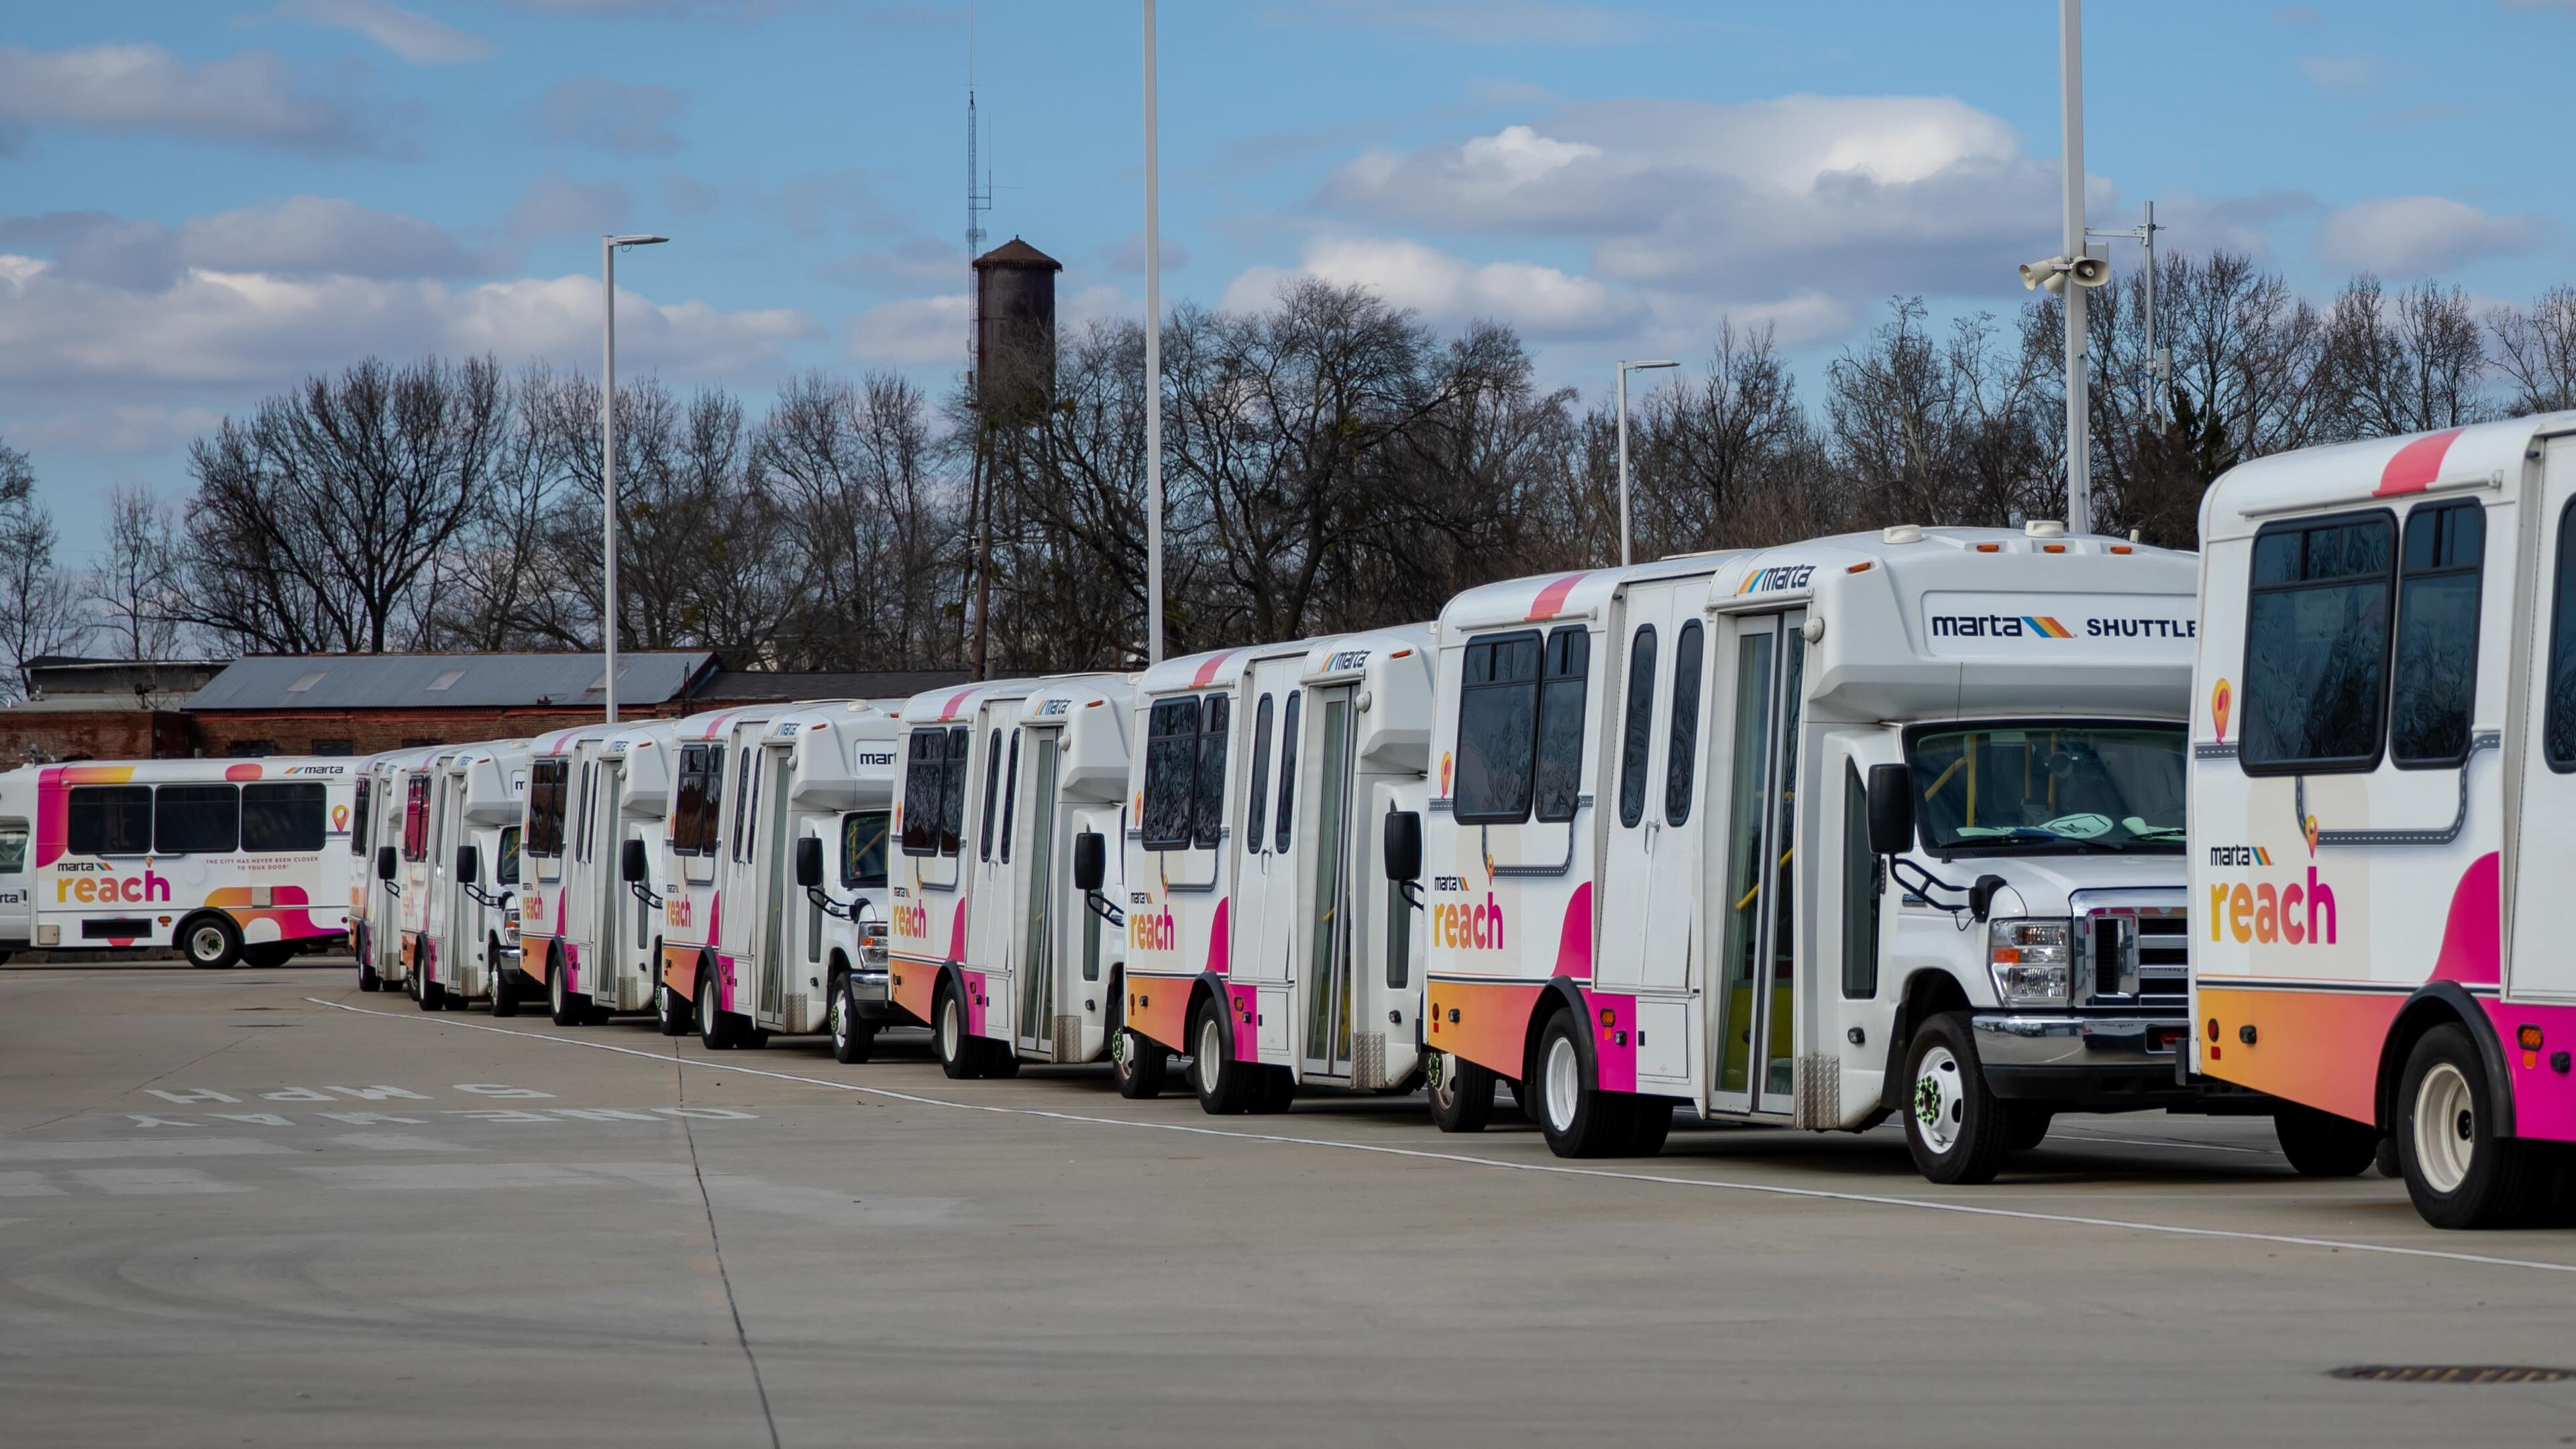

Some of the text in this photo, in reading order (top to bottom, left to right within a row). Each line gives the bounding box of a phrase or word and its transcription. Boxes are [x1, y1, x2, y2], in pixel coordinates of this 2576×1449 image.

[1761, 564, 1817, 592] marta
[1932, 614, 2196, 637] marta SHUTTLE
[1335, 649, 1372, 670] marta
[860, 753, 897, 765] mar
[58, 861, 94, 871] marta
[2210, 845, 2250, 866] marta
[57, 870, 170, 903] reach
[1434, 875, 1457, 891] marta
[0, 894, 18, 903] rta
[523, 891, 543, 920] reach
[2210, 865, 2337, 945] reach
[667, 894, 691, 928] reach
[894, 899, 926, 938] reach
[1434, 892, 1503, 950] reach
[1130, 904, 1175, 951] reach
[144, 1085, 434, 1104] MPH
[125, 1108, 759, 1128] ONE WAY
